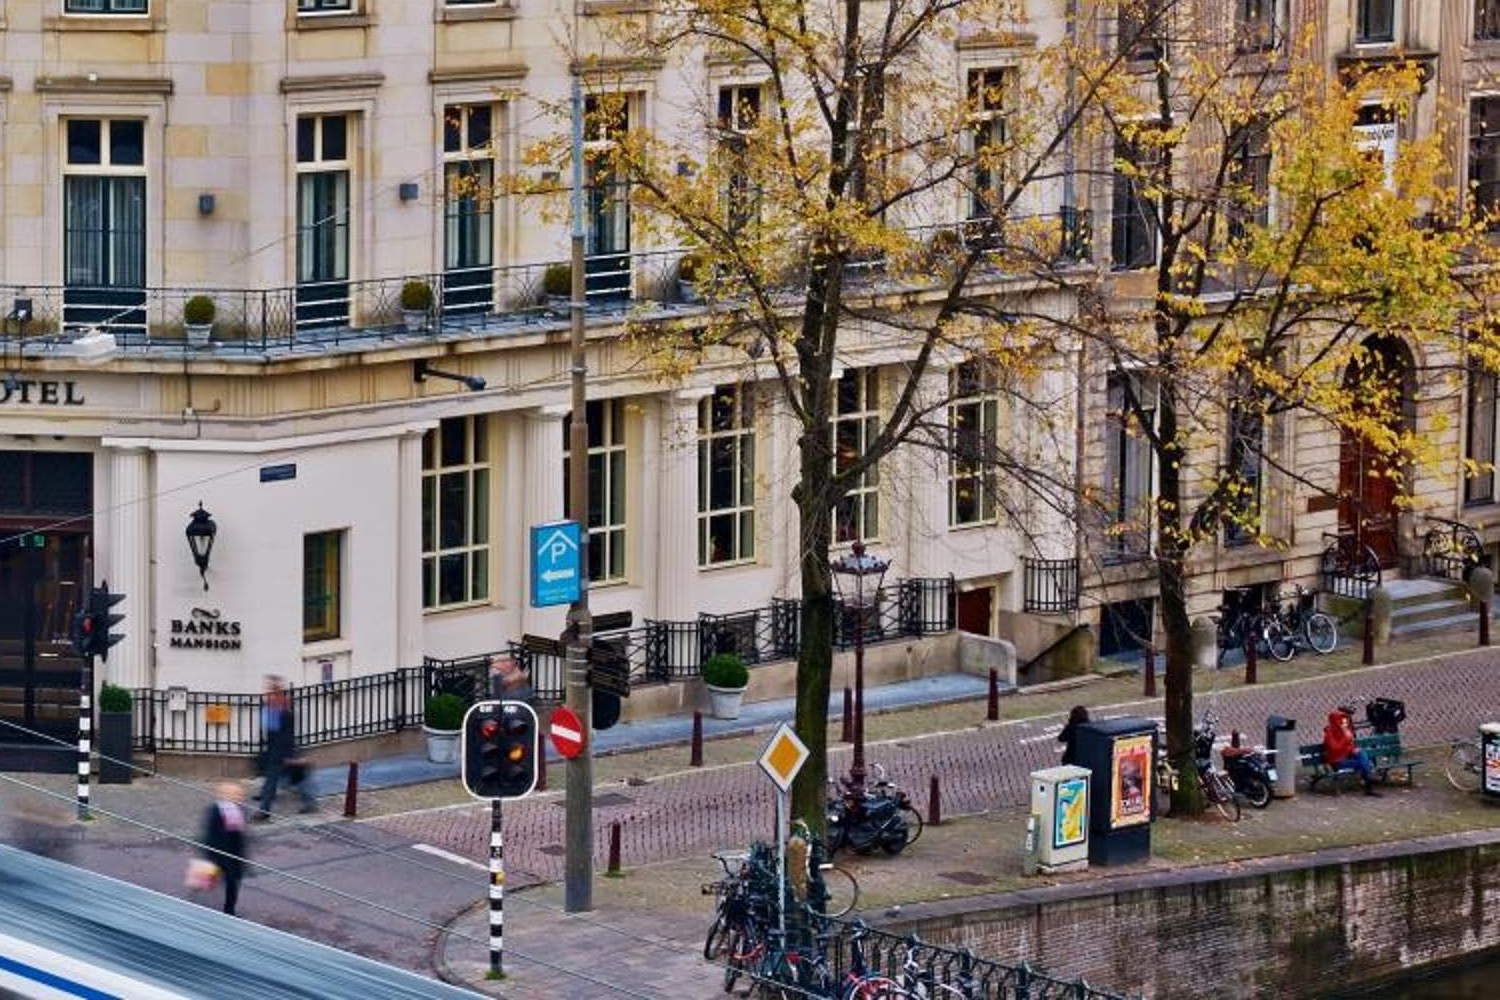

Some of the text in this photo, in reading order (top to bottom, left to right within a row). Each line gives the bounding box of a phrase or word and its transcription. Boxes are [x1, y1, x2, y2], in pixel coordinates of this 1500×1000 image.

[552, 542, 566, 564] P
[171, 620, 241, 635] BANKS
[170, 637, 241, 650] MANSION
